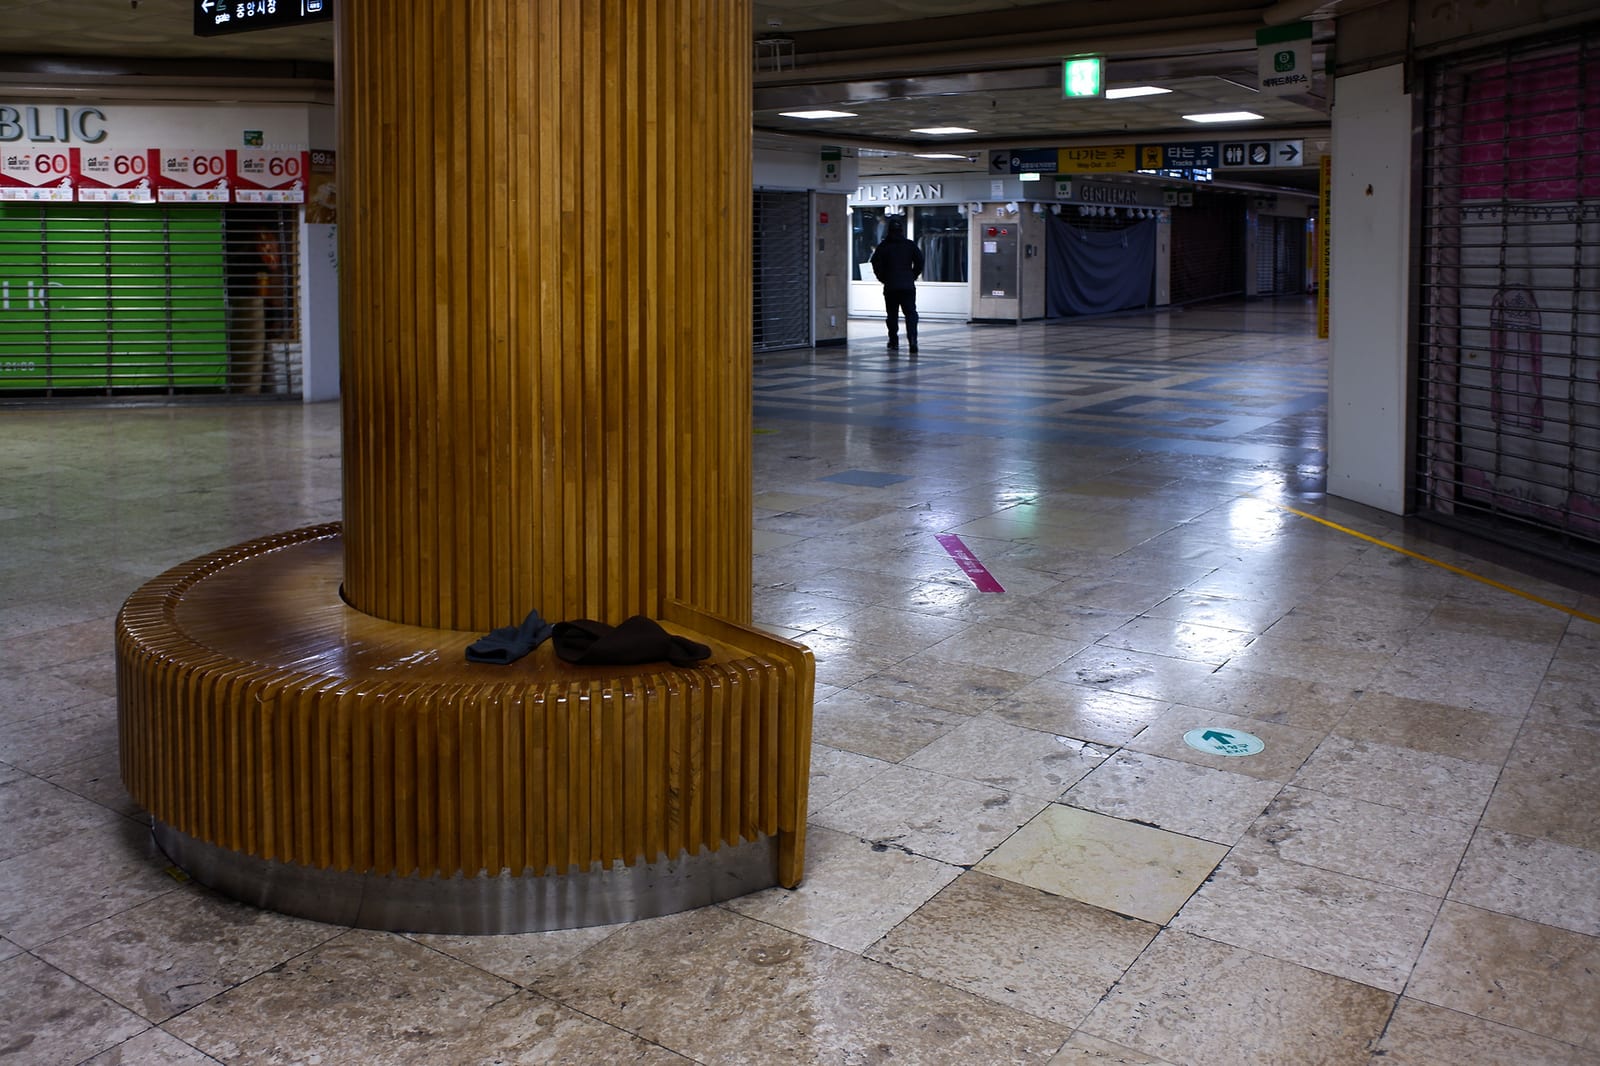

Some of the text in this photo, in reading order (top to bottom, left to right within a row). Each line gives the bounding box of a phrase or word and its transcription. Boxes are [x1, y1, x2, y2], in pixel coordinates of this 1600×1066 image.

[215, 12, 231, 24] gate
[235, 0, 277, 18] 중앙시장
[0, 106, 108, 143] BLIC
[312, 152, 326, 164] 99
[1068, 148, 1126, 160] 나가는 곳
[1167, 145, 1215, 158] 타는 곳
[35, 154, 68, 173] 60
[114, 155, 146, 175] 60
[193, 155, 225, 176] 60
[269, 157, 299, 176] 60
[847, 183, 943, 201] TLEMAN
[1081, 185, 1138, 204] GENTLEMAN
